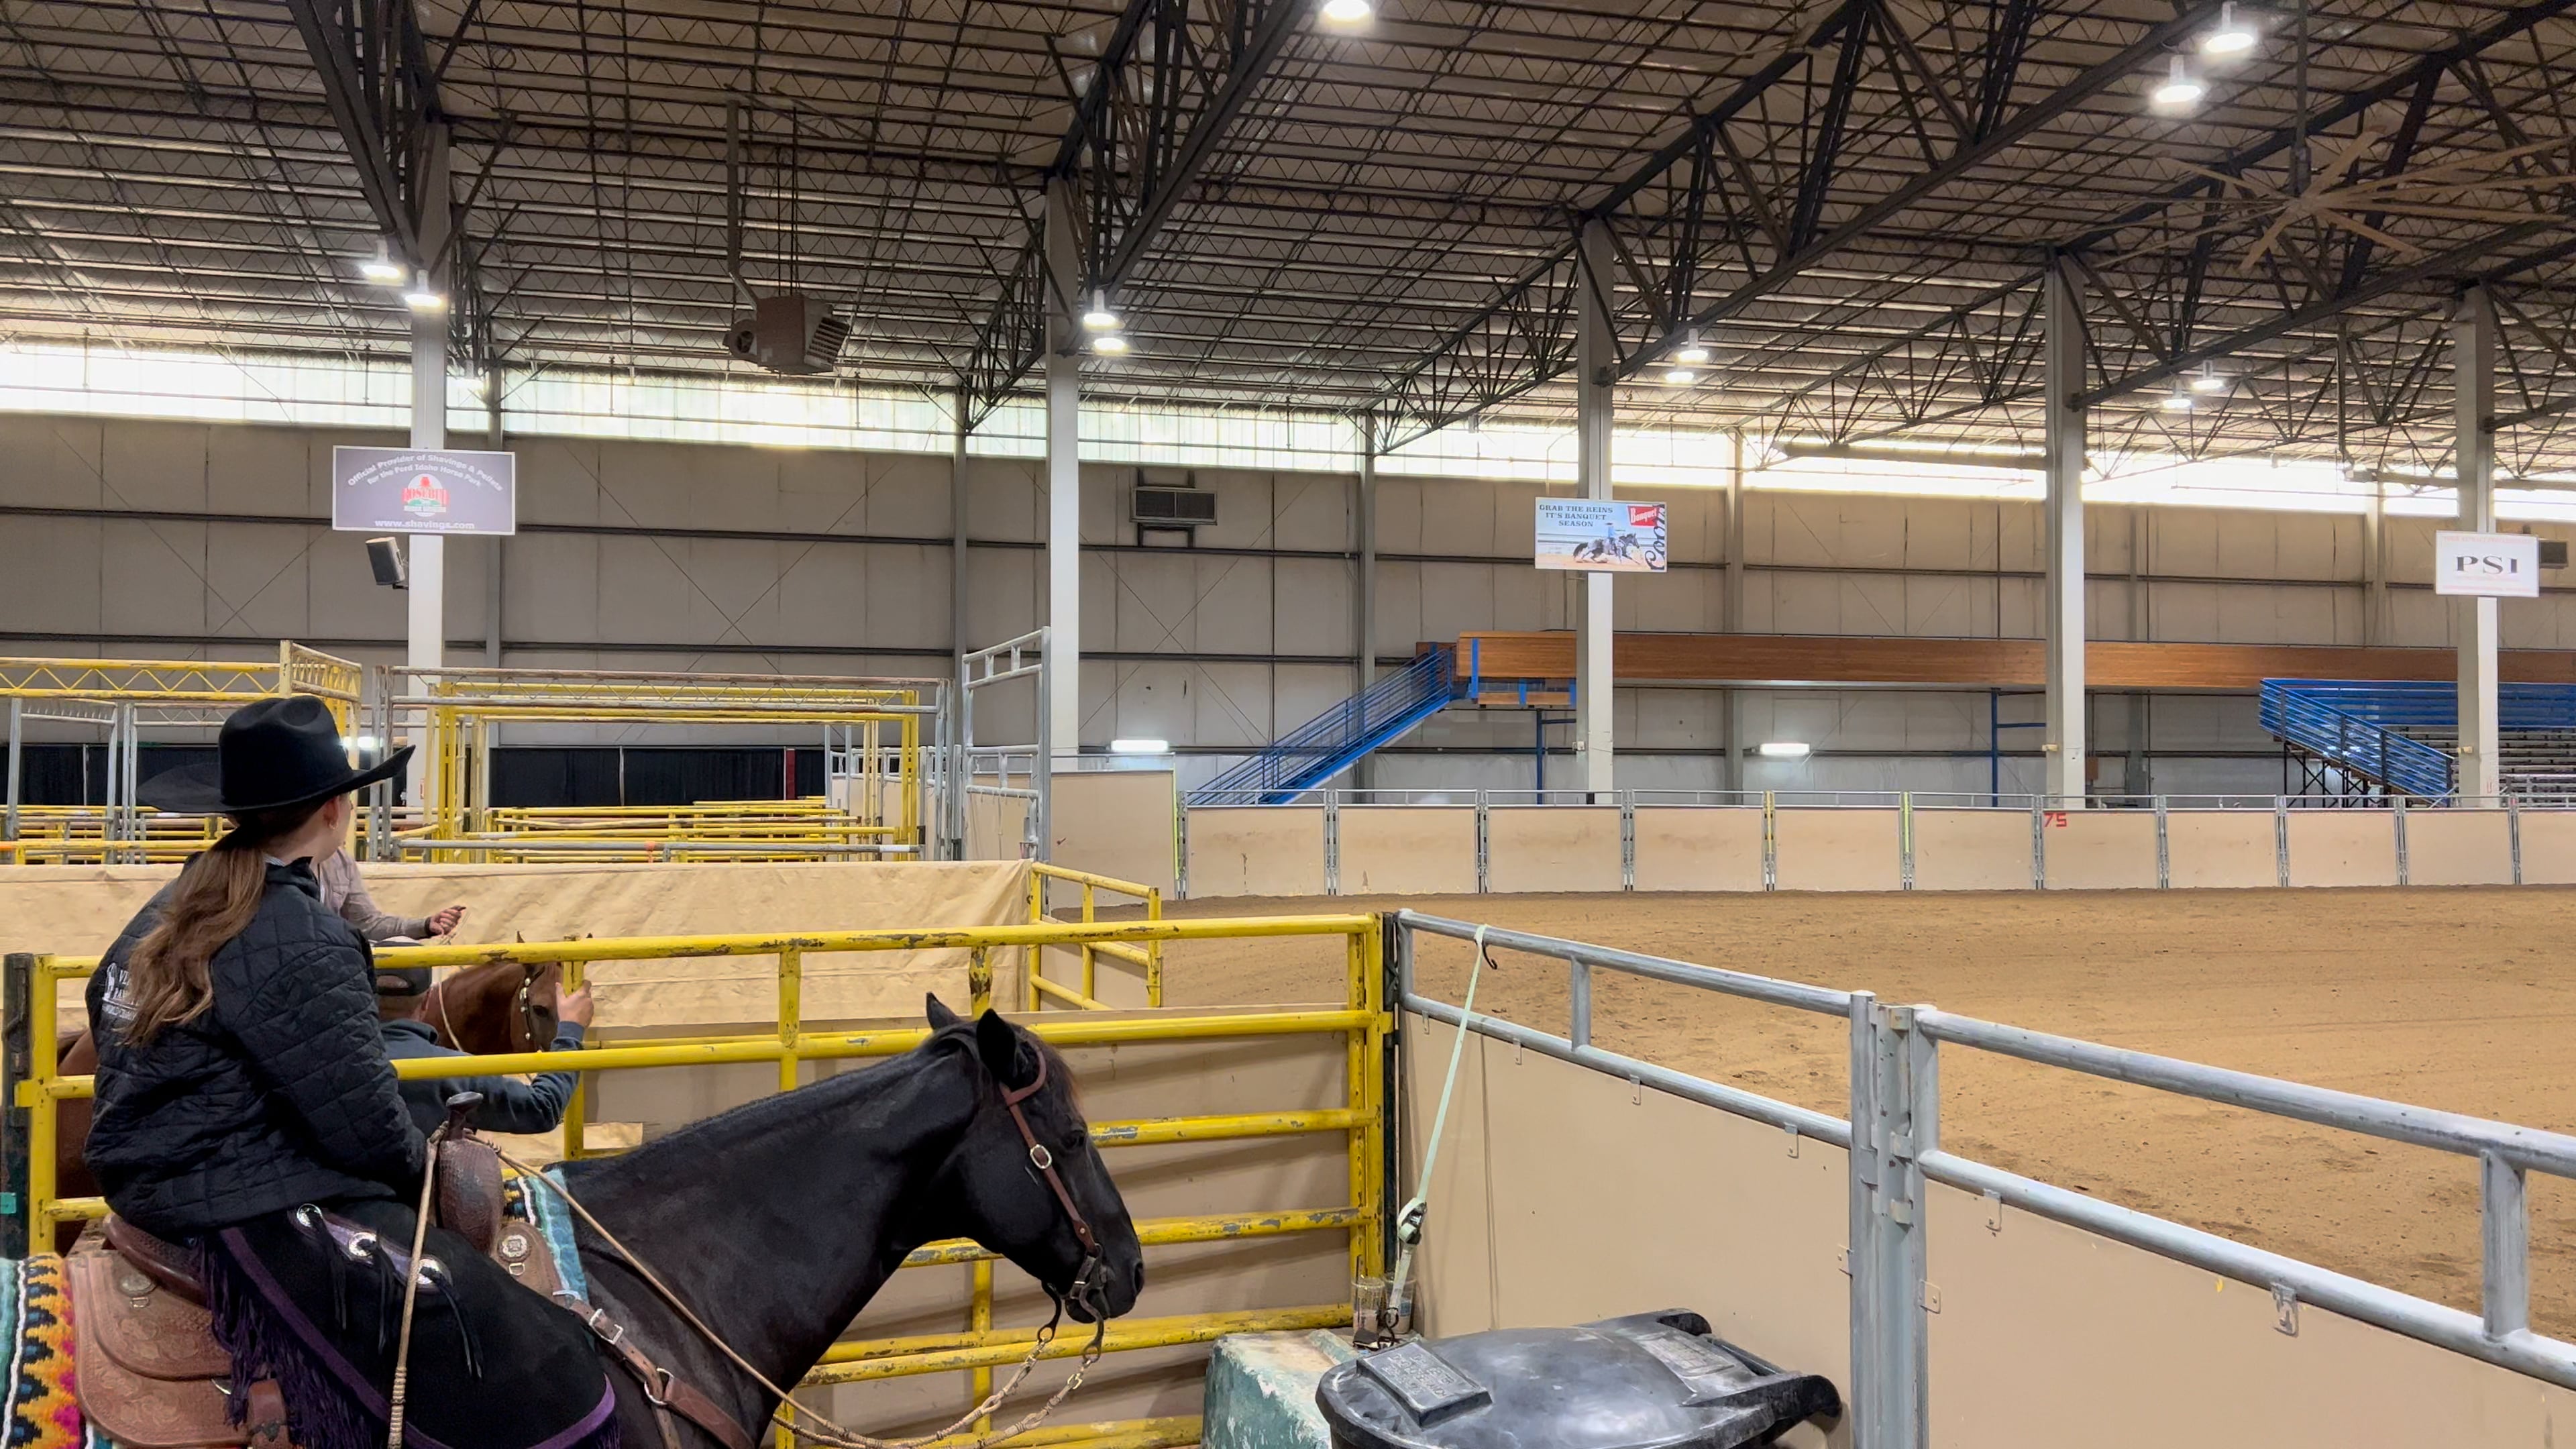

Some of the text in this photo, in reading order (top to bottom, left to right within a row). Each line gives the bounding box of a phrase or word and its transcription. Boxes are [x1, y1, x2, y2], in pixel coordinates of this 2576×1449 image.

[348, 464, 376, 486] Official
[377, 455, 415, 468] Provider
[428, 455, 467, 469] Shavings
[477, 470, 503, 492] Pellets
[367, 464, 481, 487] for the Ford Idaho Horse Park
[375, 520, 476, 529] www.shavings.com
[2455, 555, 2519, 575] PSI
[2044, 812, 2067, 827] 75
